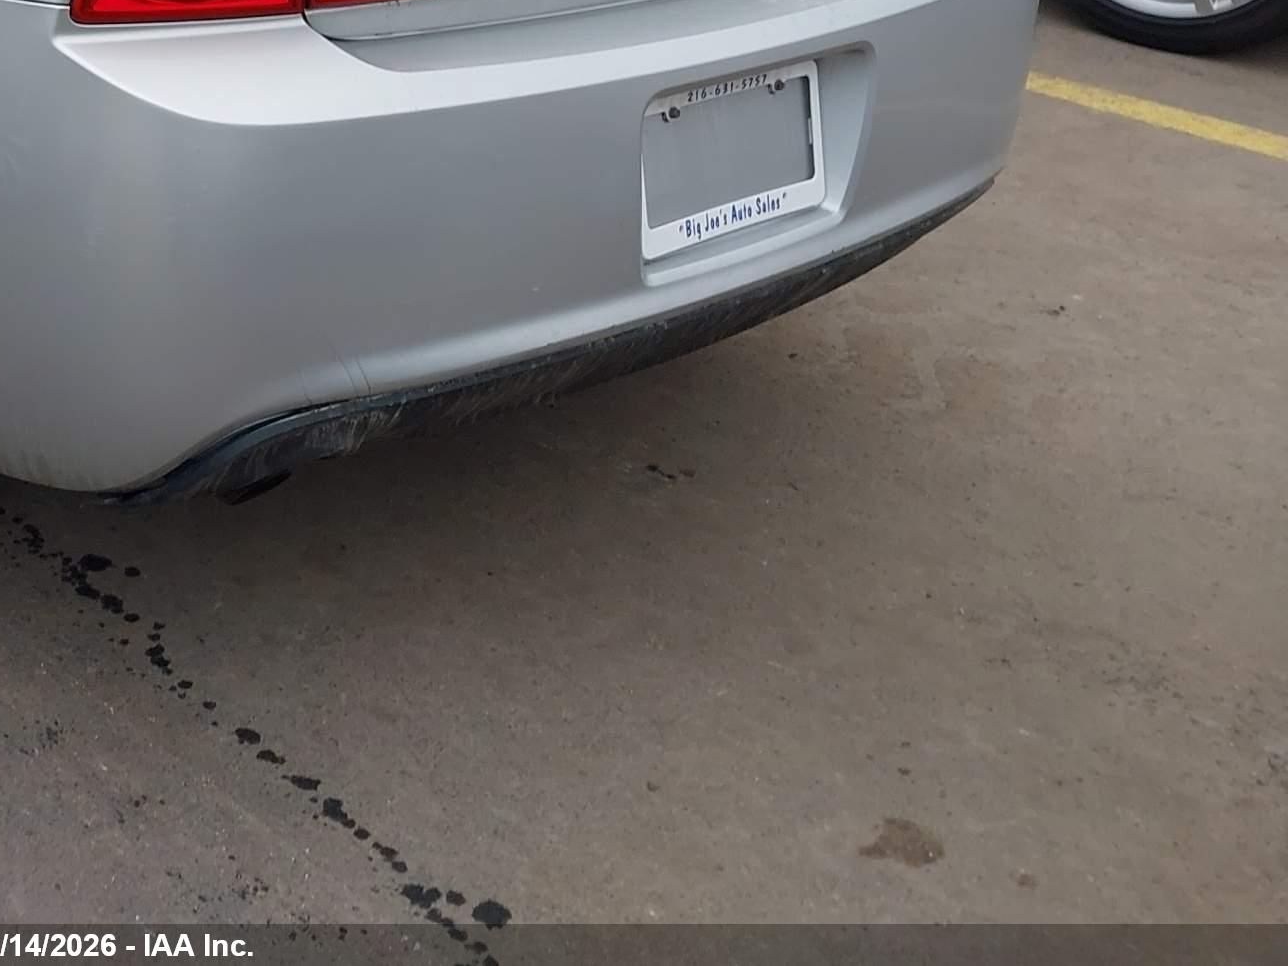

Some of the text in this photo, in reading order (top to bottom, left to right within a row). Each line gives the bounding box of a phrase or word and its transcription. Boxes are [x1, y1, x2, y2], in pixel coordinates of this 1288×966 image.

[687, 74, 768, 103] 216-631-5757
[704, 209, 728, 232] Joe's
[731, 202, 753, 224] Auto
